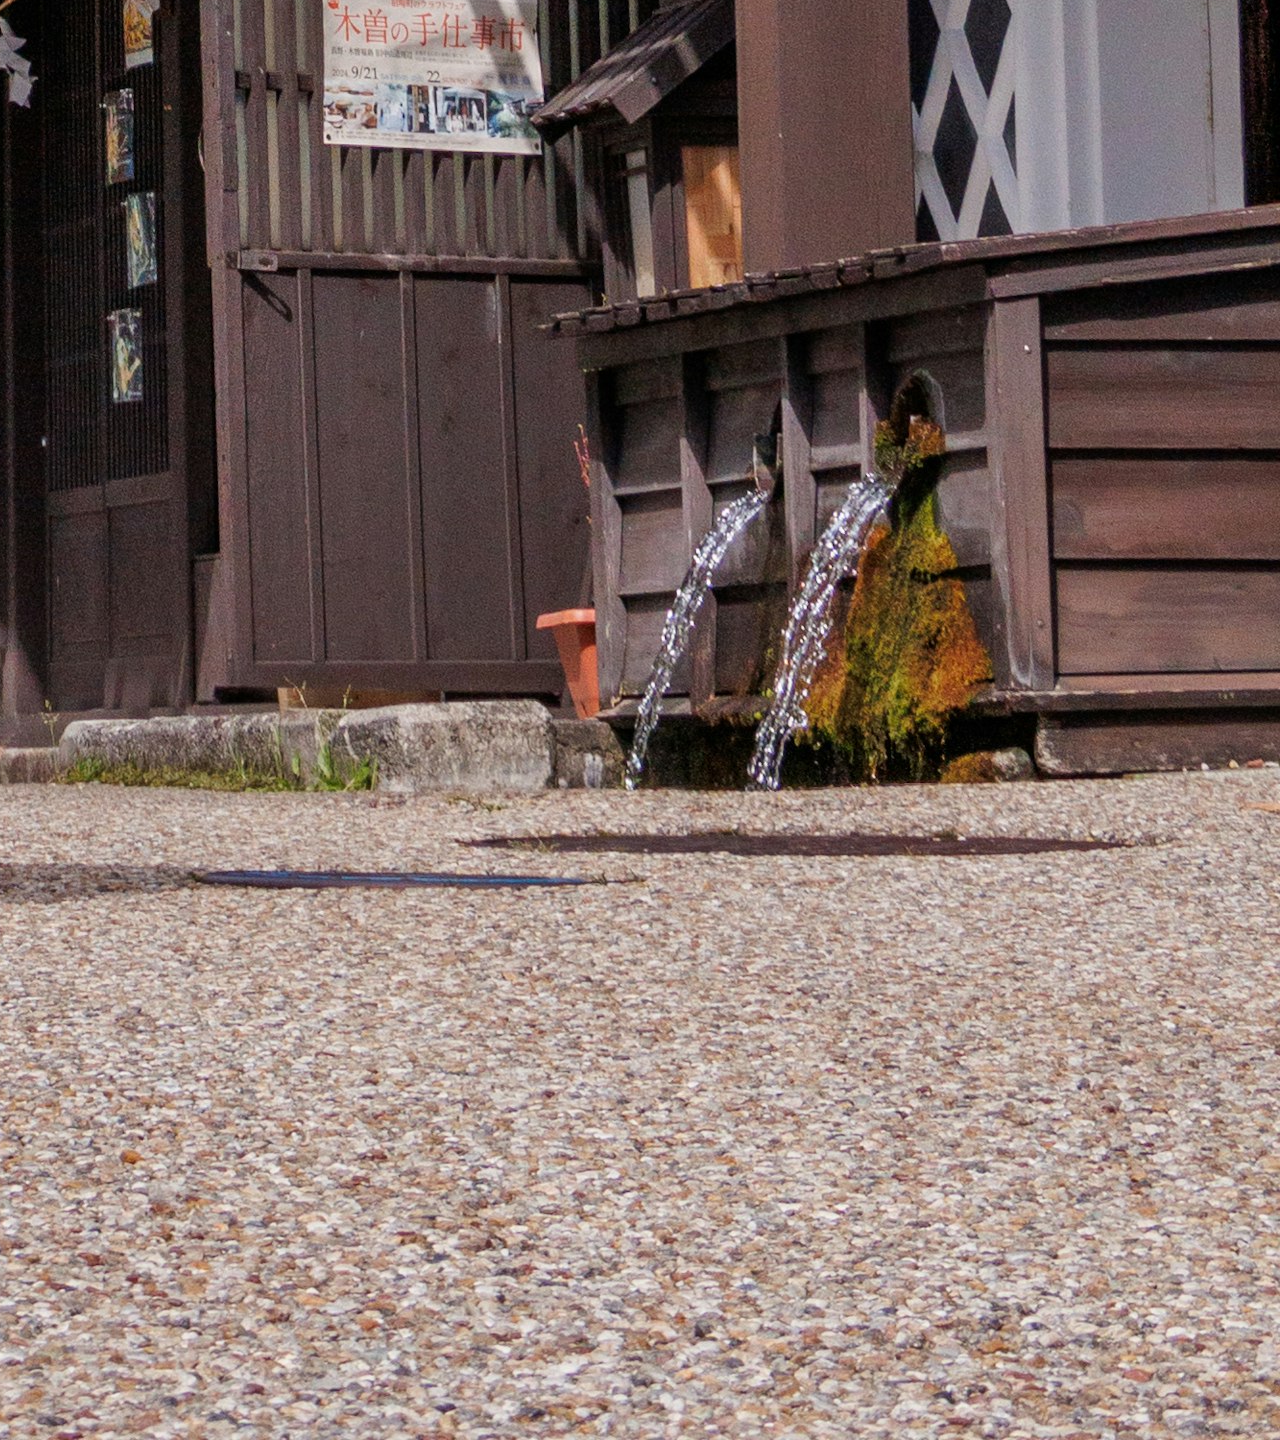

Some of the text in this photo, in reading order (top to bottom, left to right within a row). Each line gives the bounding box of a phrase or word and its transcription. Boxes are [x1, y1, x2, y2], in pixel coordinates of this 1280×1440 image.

[333, 5, 526, 53] 木曽の手仕事市
[351, 64, 380, 80] 9/21
[426, 70, 441, 83] 22
